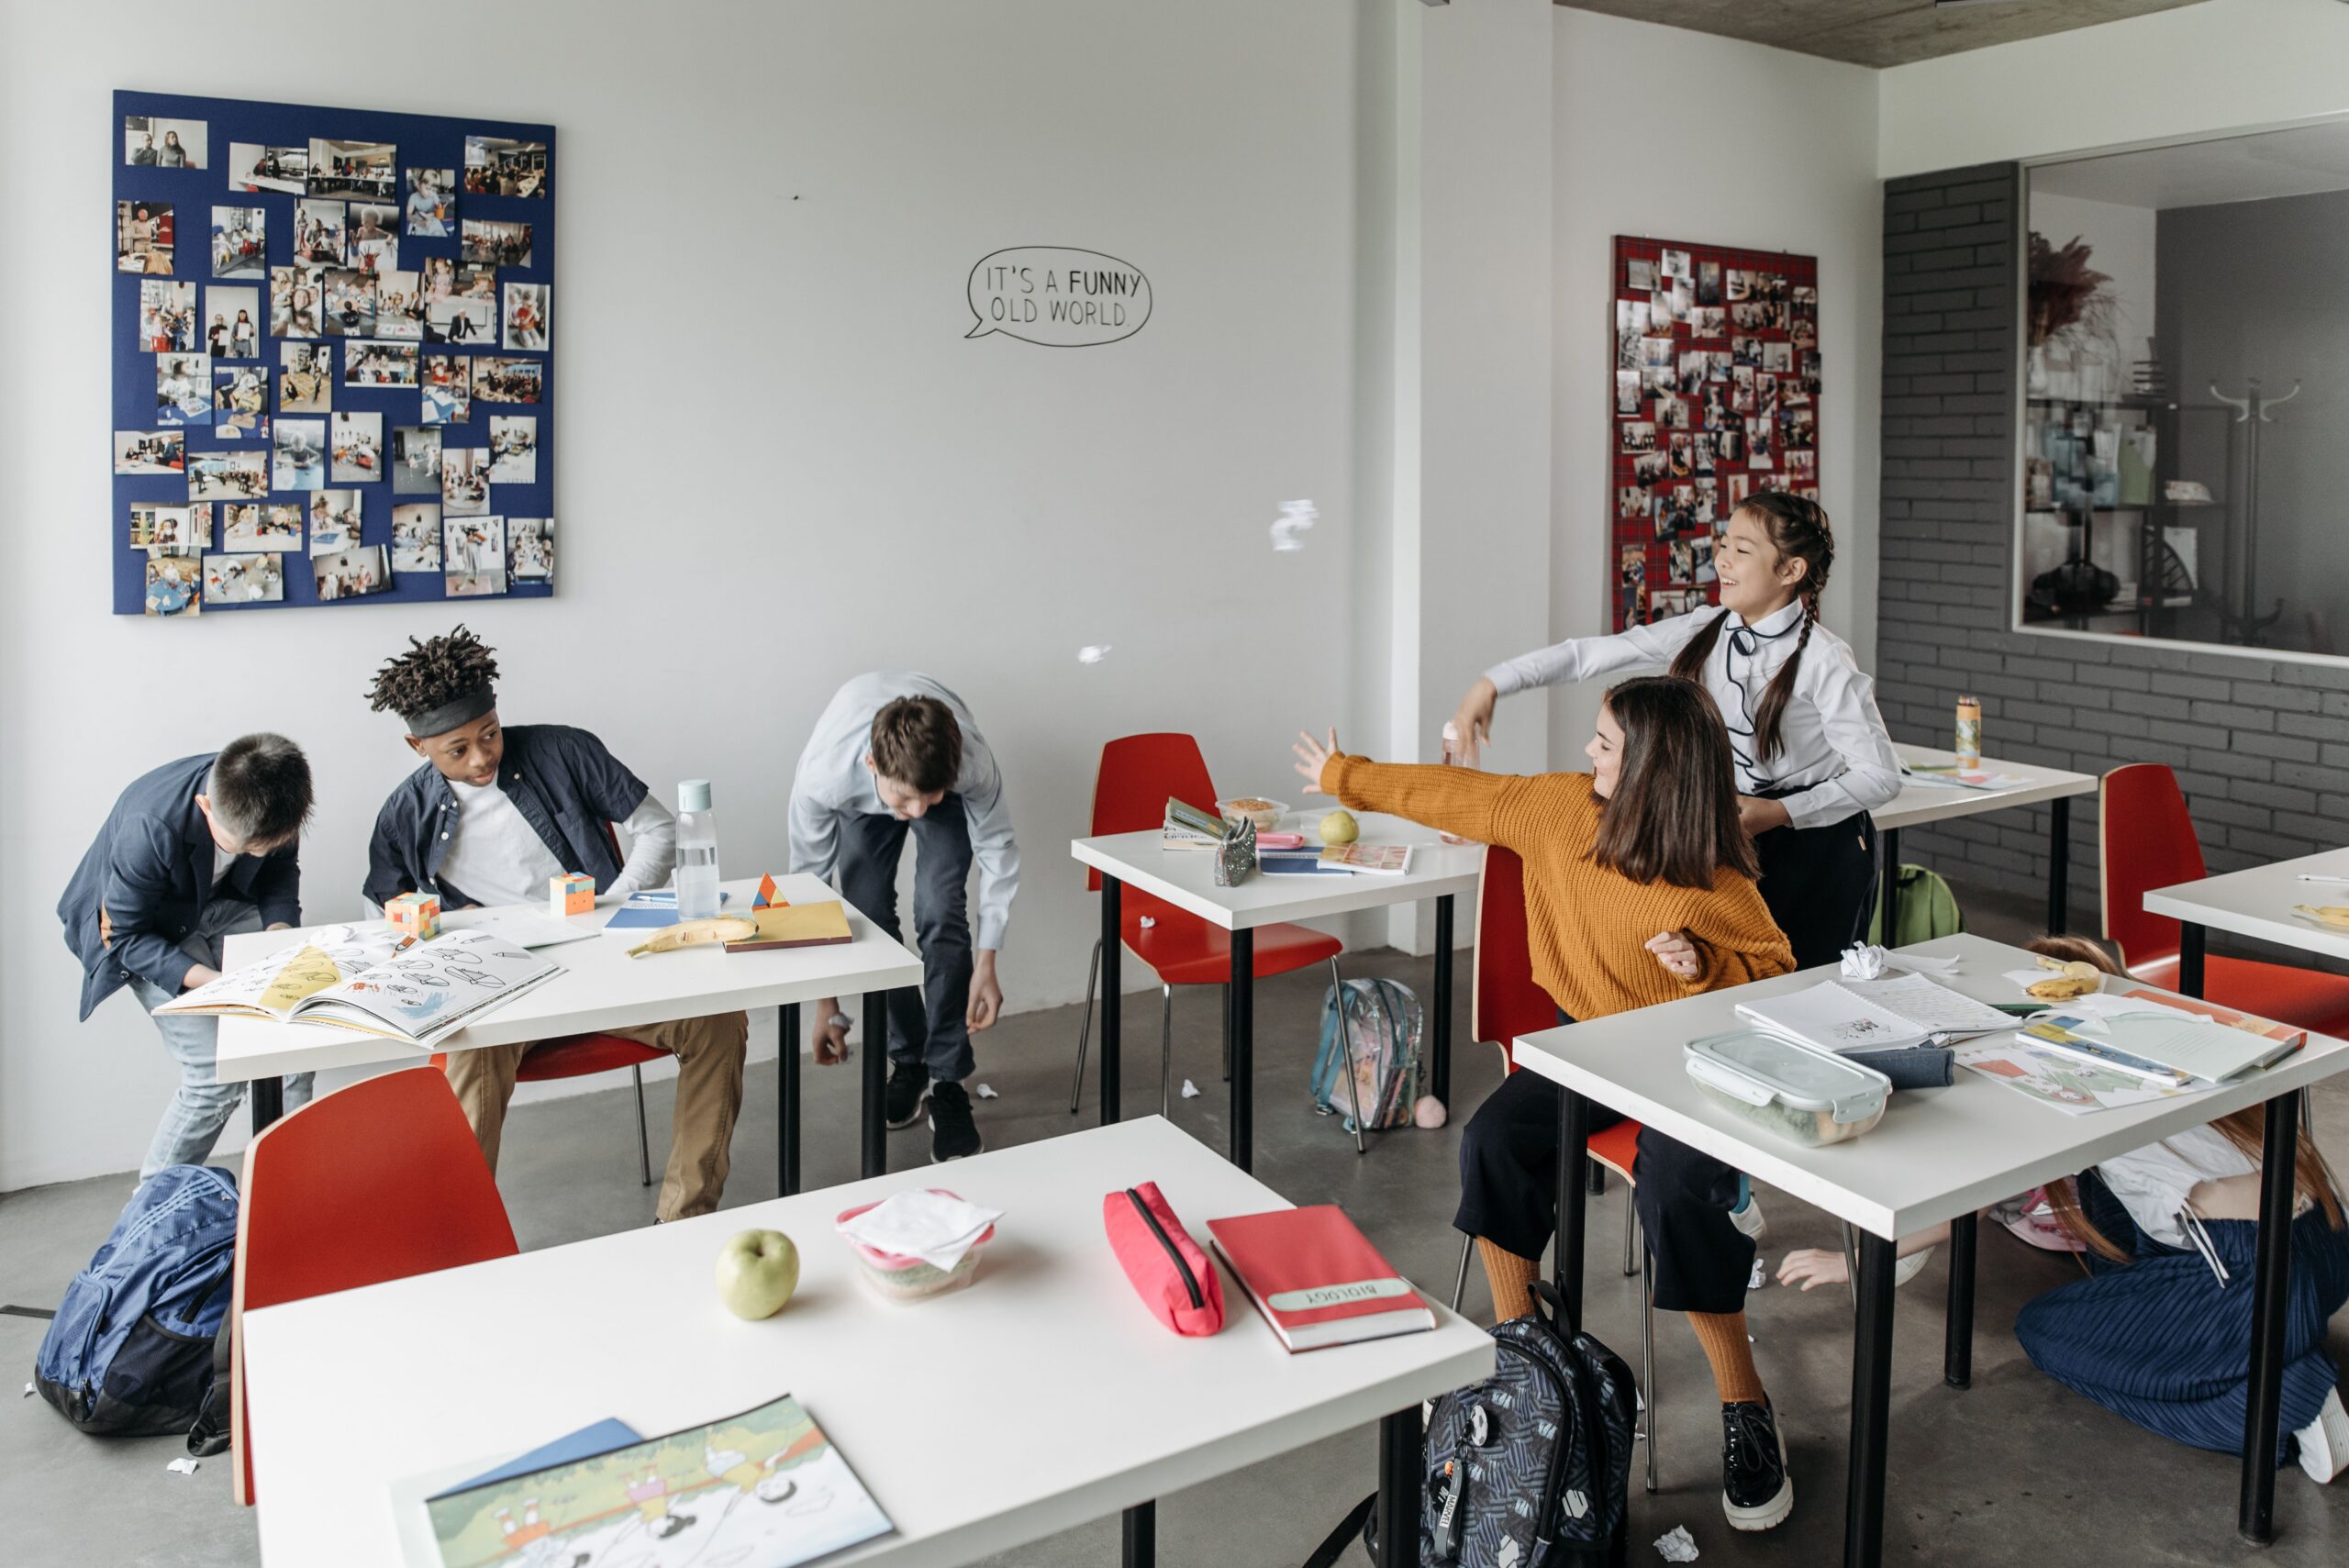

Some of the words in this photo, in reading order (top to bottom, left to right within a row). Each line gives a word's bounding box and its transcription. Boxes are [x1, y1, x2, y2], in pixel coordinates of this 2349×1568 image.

[987, 266, 1035, 294] IT'S
[1045, 270, 1059, 294] A
[1069, 270, 1141, 298] FUNNY
[991, 296, 1038, 322] OLD
[1307, 1284, 1377, 1304] BIOLOGY
[1441, 1496, 1456, 1525] MARVEL
